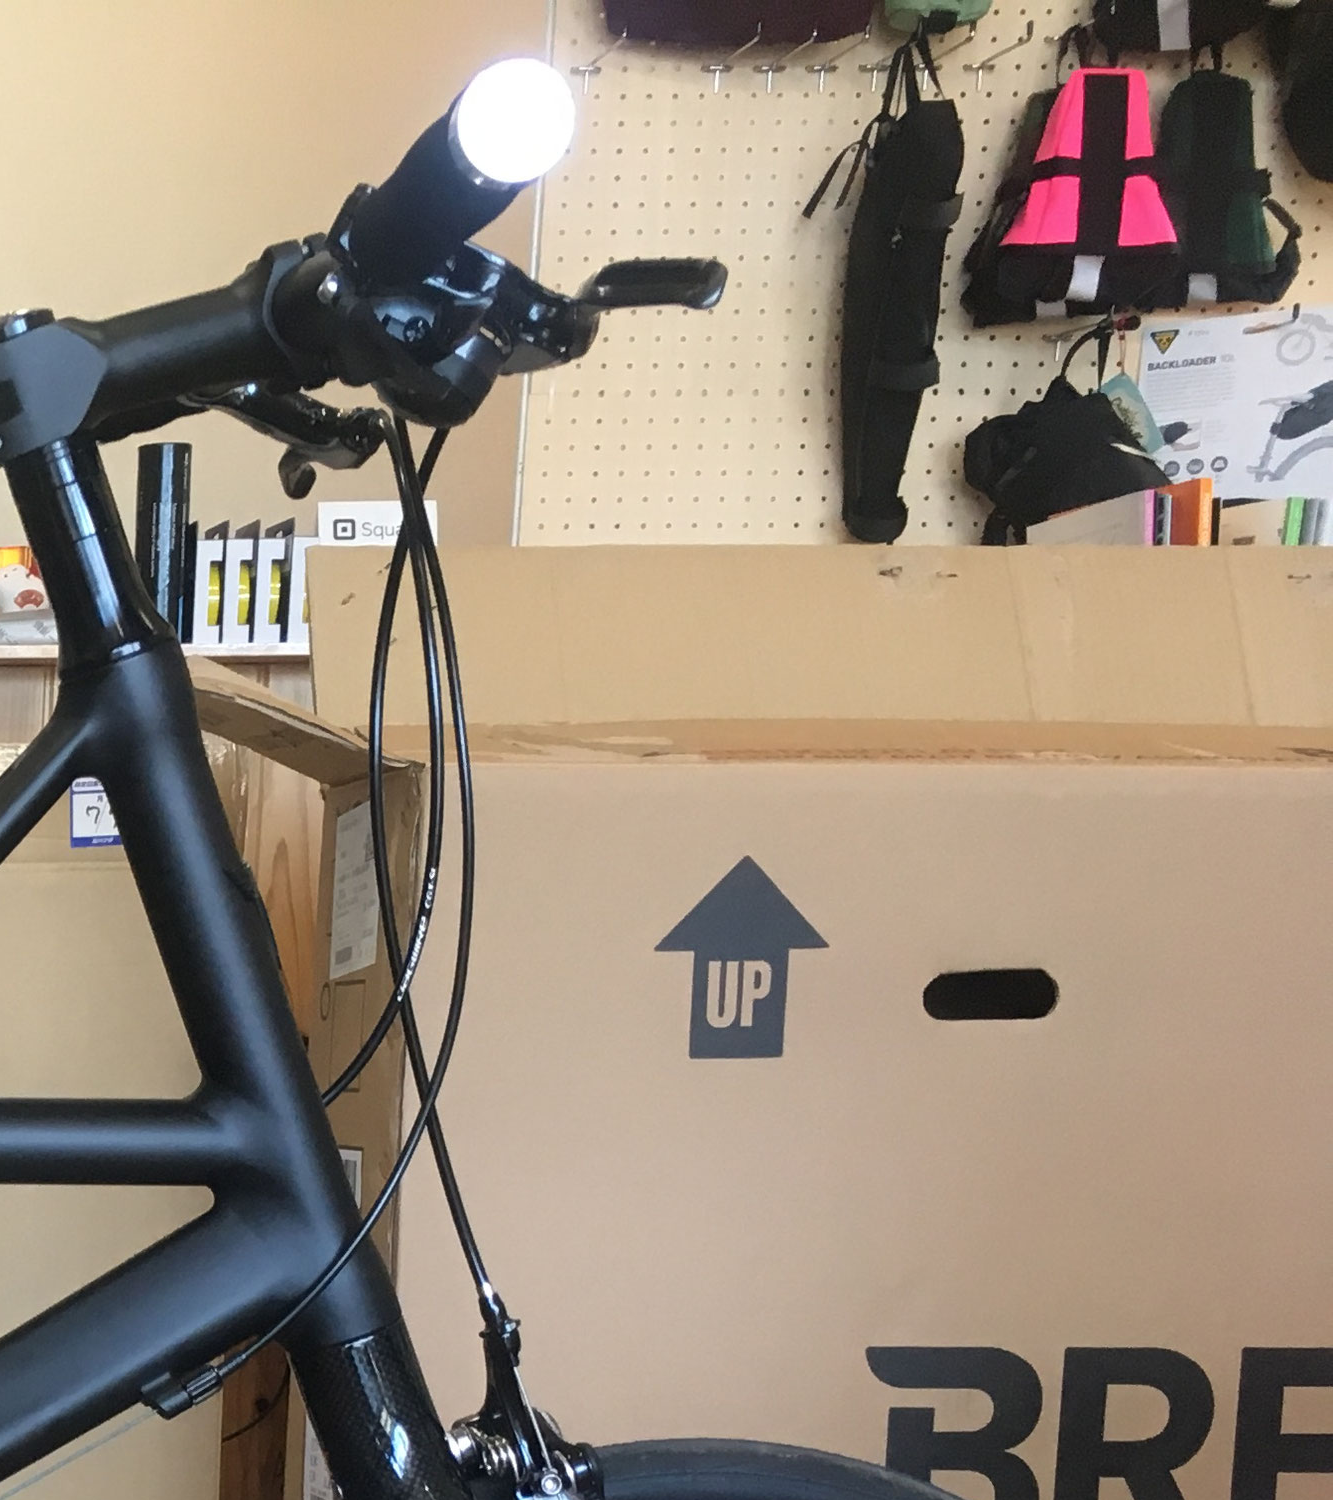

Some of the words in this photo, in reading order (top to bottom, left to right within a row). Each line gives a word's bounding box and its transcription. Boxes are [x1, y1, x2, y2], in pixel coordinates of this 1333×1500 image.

[1147, 356, 1216, 371] BACKLOADER
[361, 521, 402, 538] Squa
[705, 959, 773, 1028] UP
